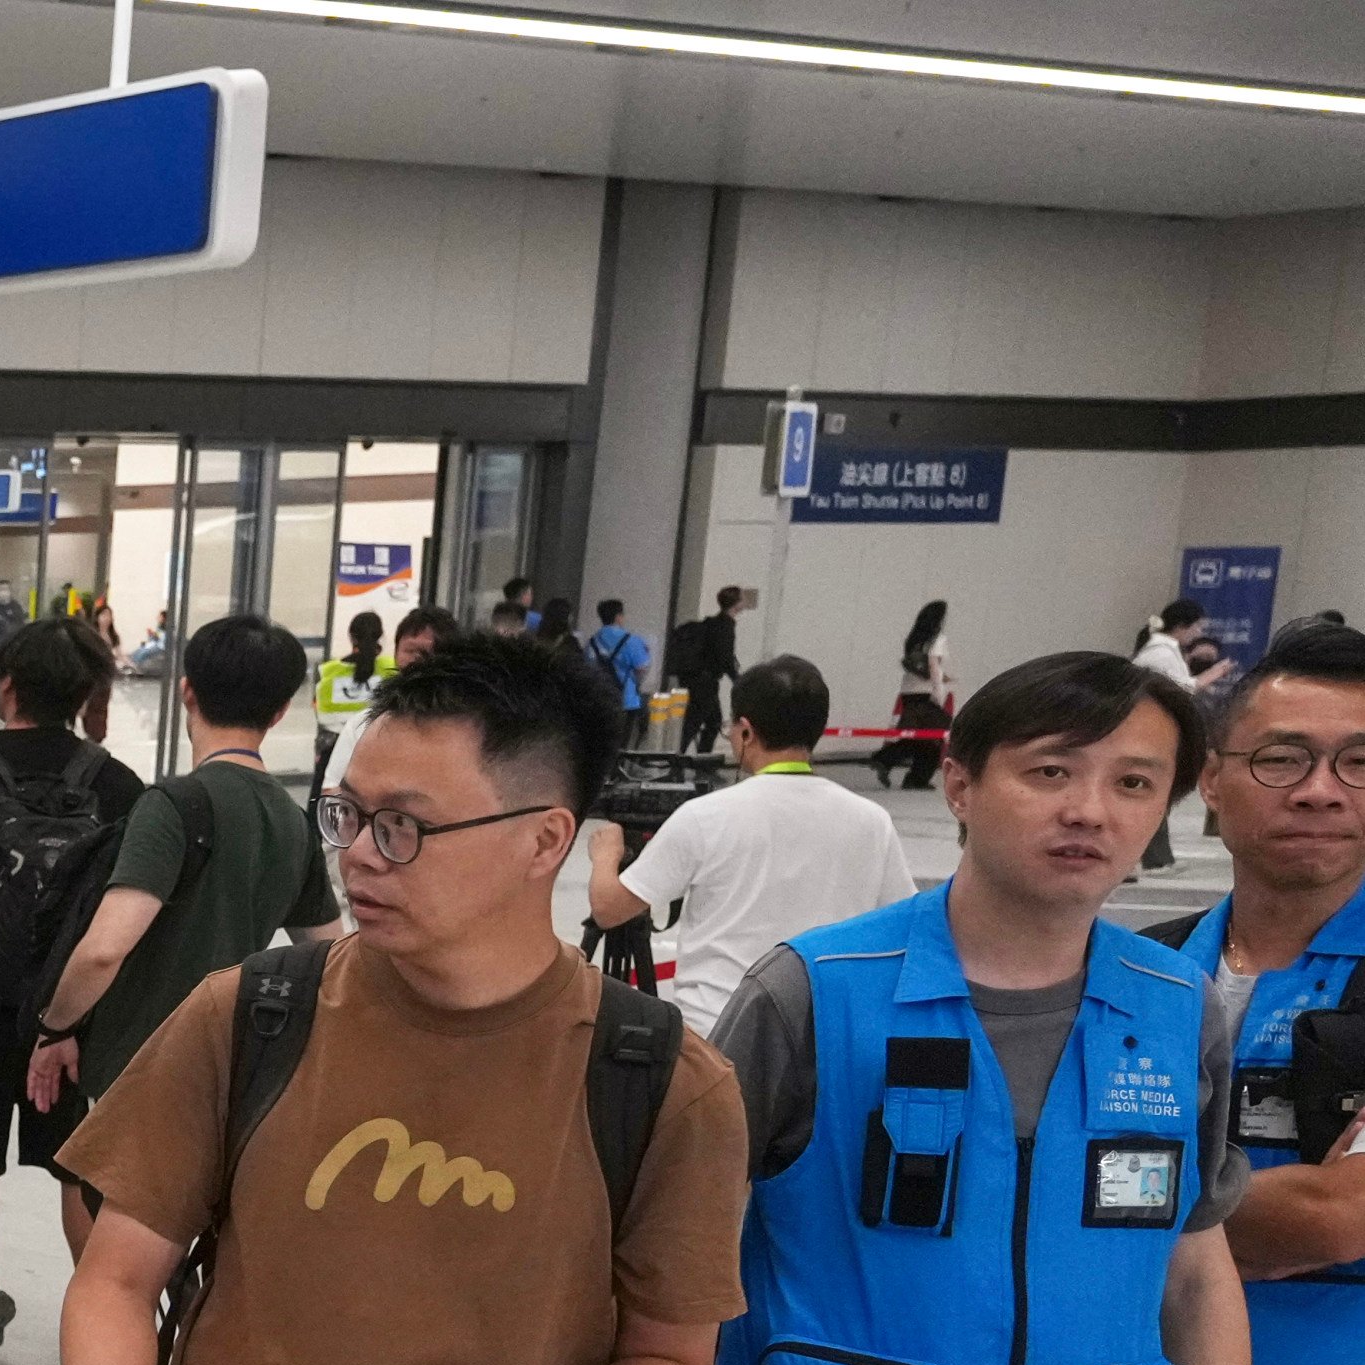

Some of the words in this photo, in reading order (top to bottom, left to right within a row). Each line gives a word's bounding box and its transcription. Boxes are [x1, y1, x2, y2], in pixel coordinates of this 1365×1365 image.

[793, 426, 805, 463] 9
[1141, 1090, 1175, 1104] MEDIA
[1142, 1103, 1181, 1117] CADRE
